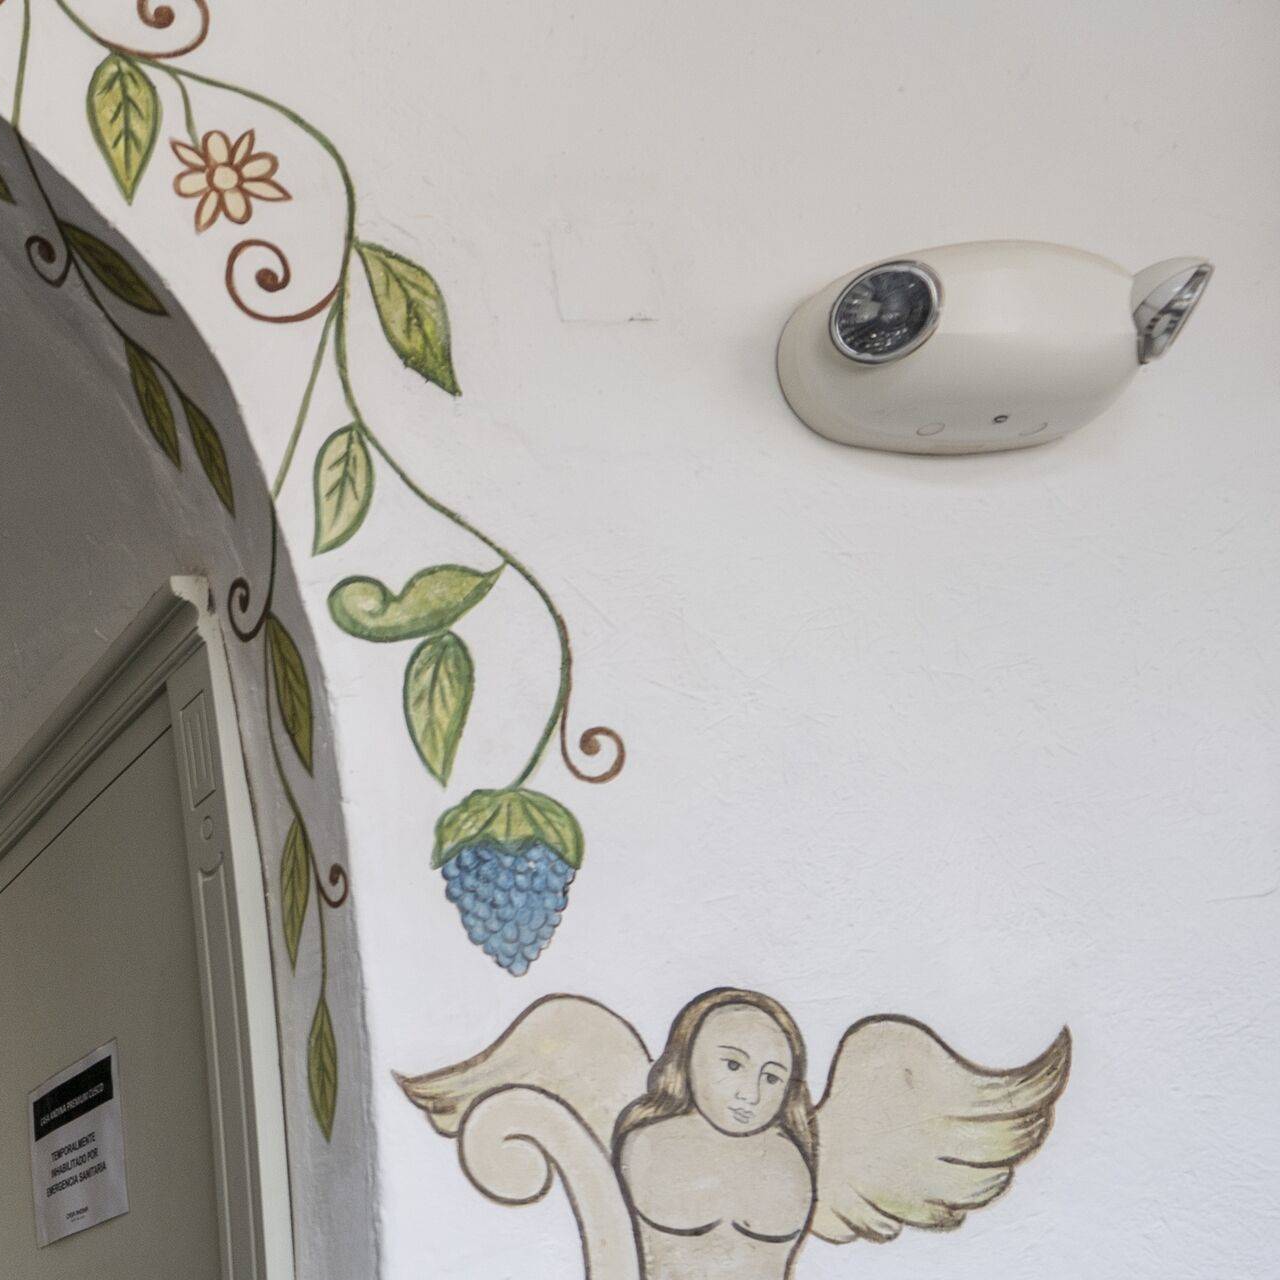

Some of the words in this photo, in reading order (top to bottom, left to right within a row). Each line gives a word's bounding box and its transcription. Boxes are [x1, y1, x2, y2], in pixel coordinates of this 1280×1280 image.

[51, 1131, 95, 1162] TEMPORALMENTE
[46, 1174, 78, 1196] EMERGENCIA
[79, 1161, 106, 1182] SANITARIA
[51, 1153, 86, 1178] INHABILITADO
[87, 1148, 98, 1160] POR
